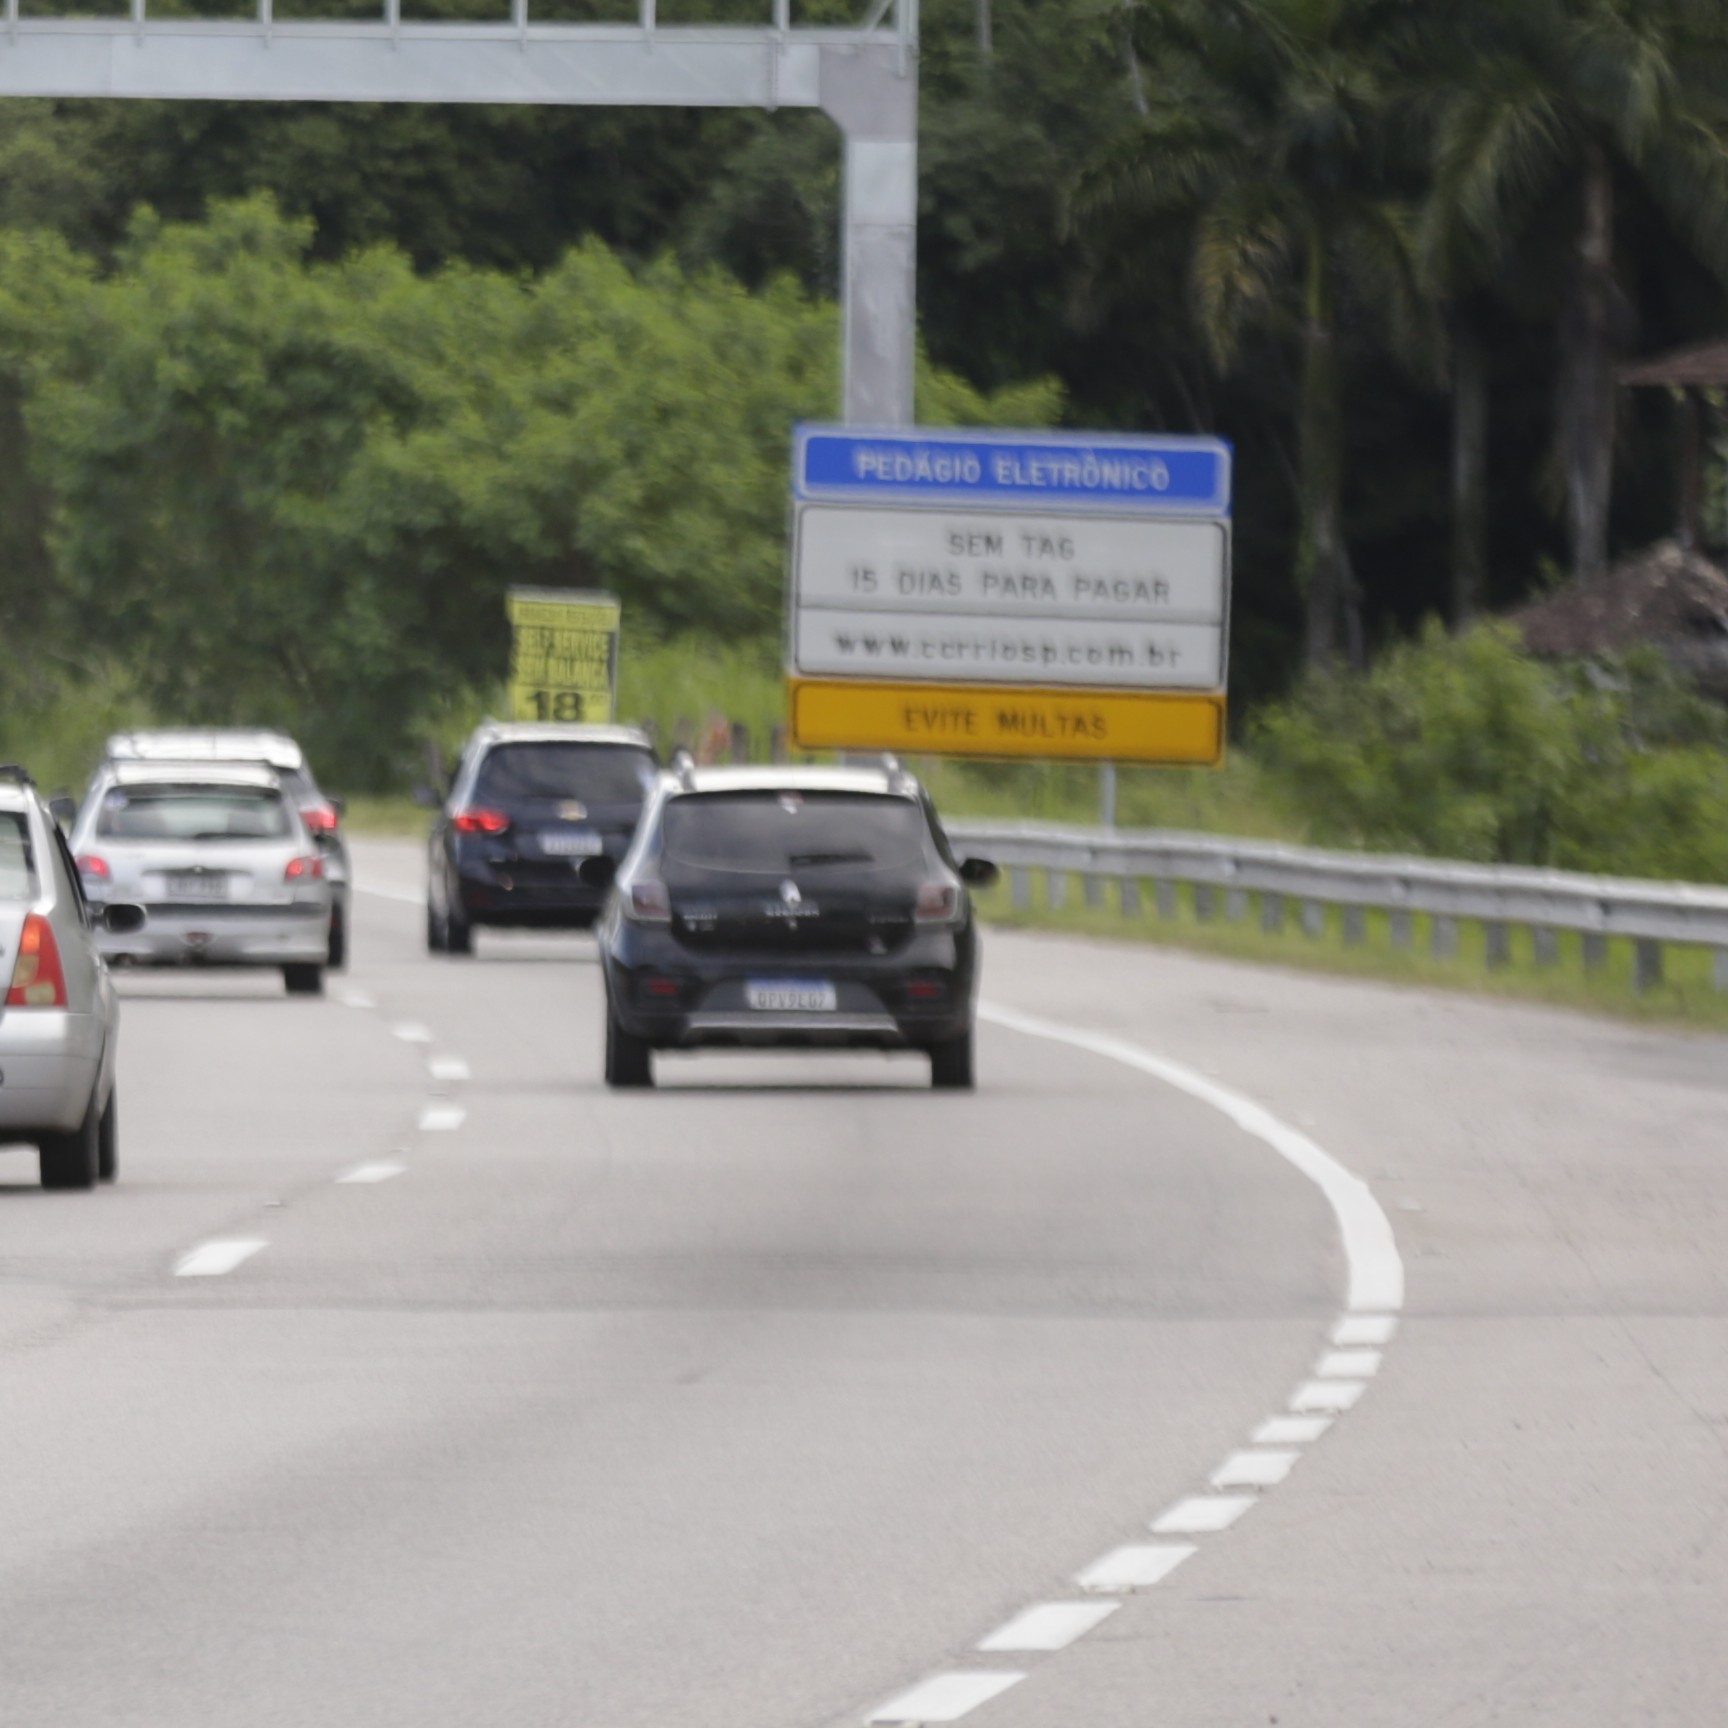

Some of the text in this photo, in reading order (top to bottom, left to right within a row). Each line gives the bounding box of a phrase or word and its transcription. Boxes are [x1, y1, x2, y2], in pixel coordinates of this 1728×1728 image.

[856, 443, 1171, 491] PEDÁGIO ELETRÔNICO
[947, 531, 1075, 560] SEM TAG
[852, 566, 1170, 604] 15 DIAS PARA PAGAR
[525, 690, 583, 722] 18
[904, 706, 1108, 741] EVITE MULTAS
